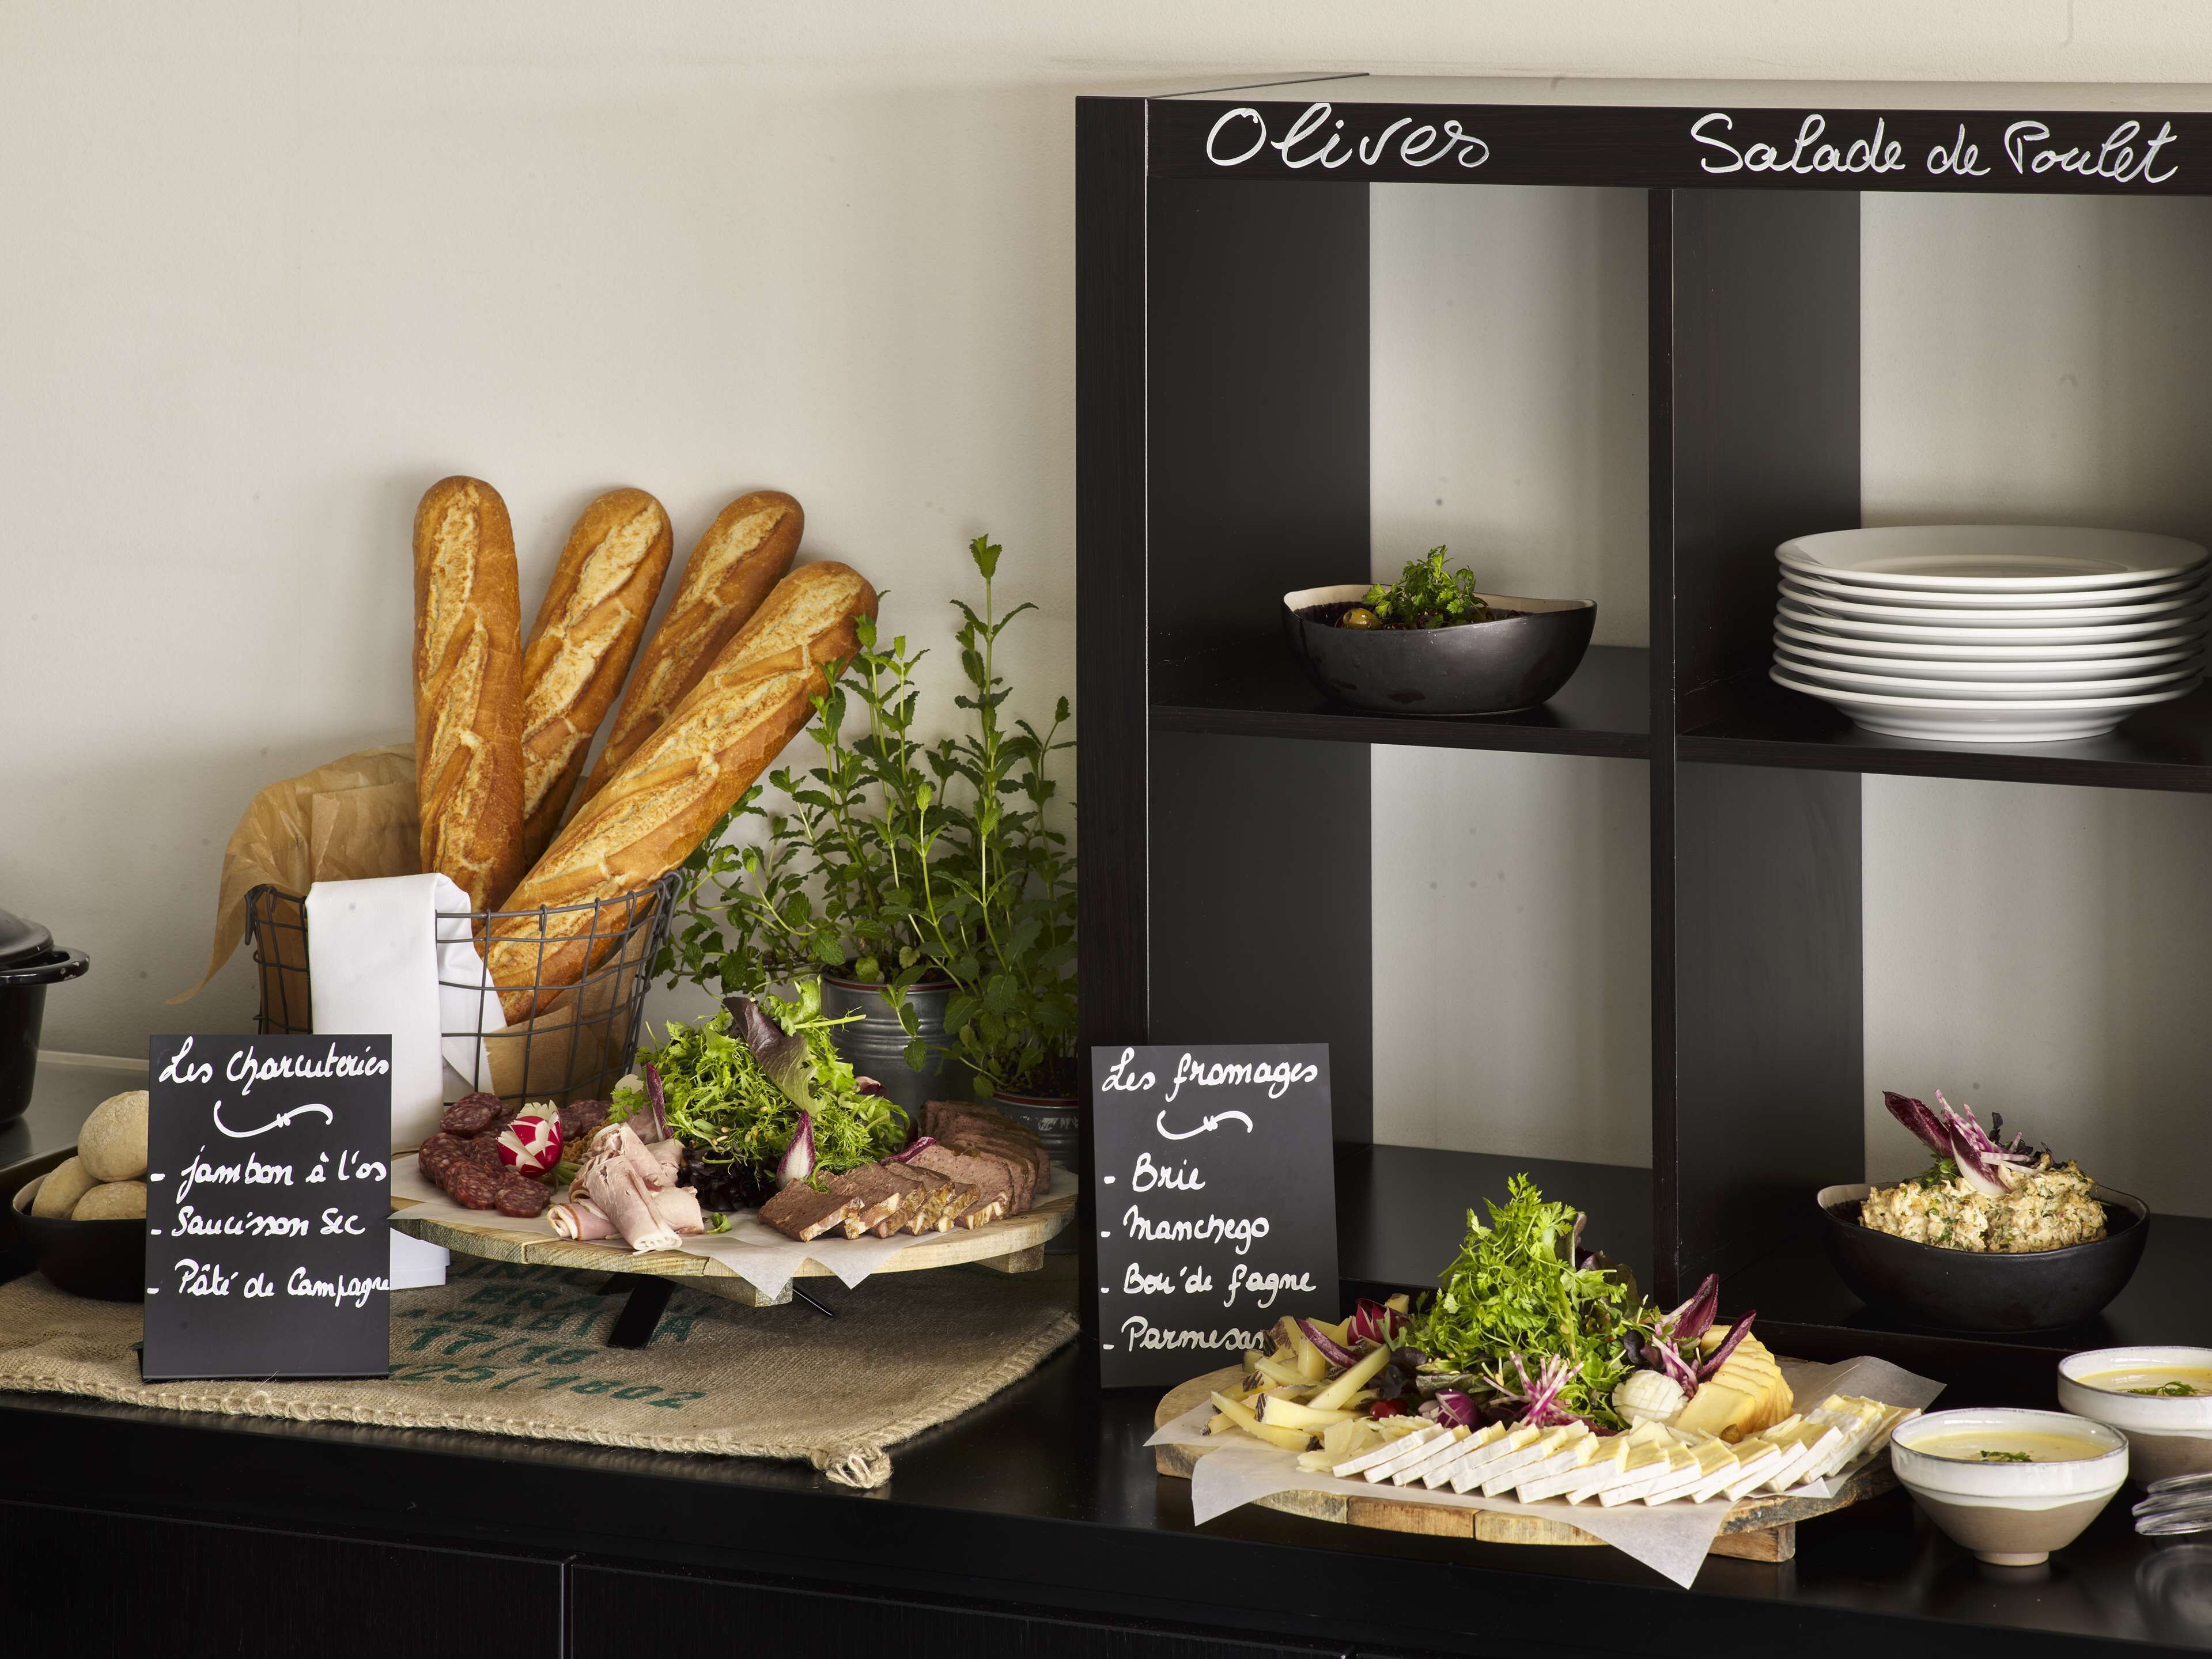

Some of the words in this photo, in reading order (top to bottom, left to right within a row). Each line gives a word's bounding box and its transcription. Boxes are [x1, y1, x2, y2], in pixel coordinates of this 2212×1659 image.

[1206, 102, 1489, 169] Olives
[1689, 112, 1906, 173] Salade
[1926, 123, 1991, 176] de
[2004, 120, 2178, 184] Poulet
[158, 1036, 213, 1084] Les
[1101, 1047, 1156, 1092] Les
[1165, 1052, 1318, 1103] fromages
[176, 1145, 294, 1205] jambon
[305, 1152, 330, 1183] à
[338, 1149, 387, 1181] l'os
[1132, 1152, 1206, 1192] Brie
[171, 1205, 309, 1238] Saucisson
[320, 1207, 366, 1235] Sec
[175, 1258, 239, 1297] Pâté
[243, 1272, 275, 1298] de
[287, 1266, 390, 1308] Campagne
[1223, 1263, 1317, 1309] fagne
